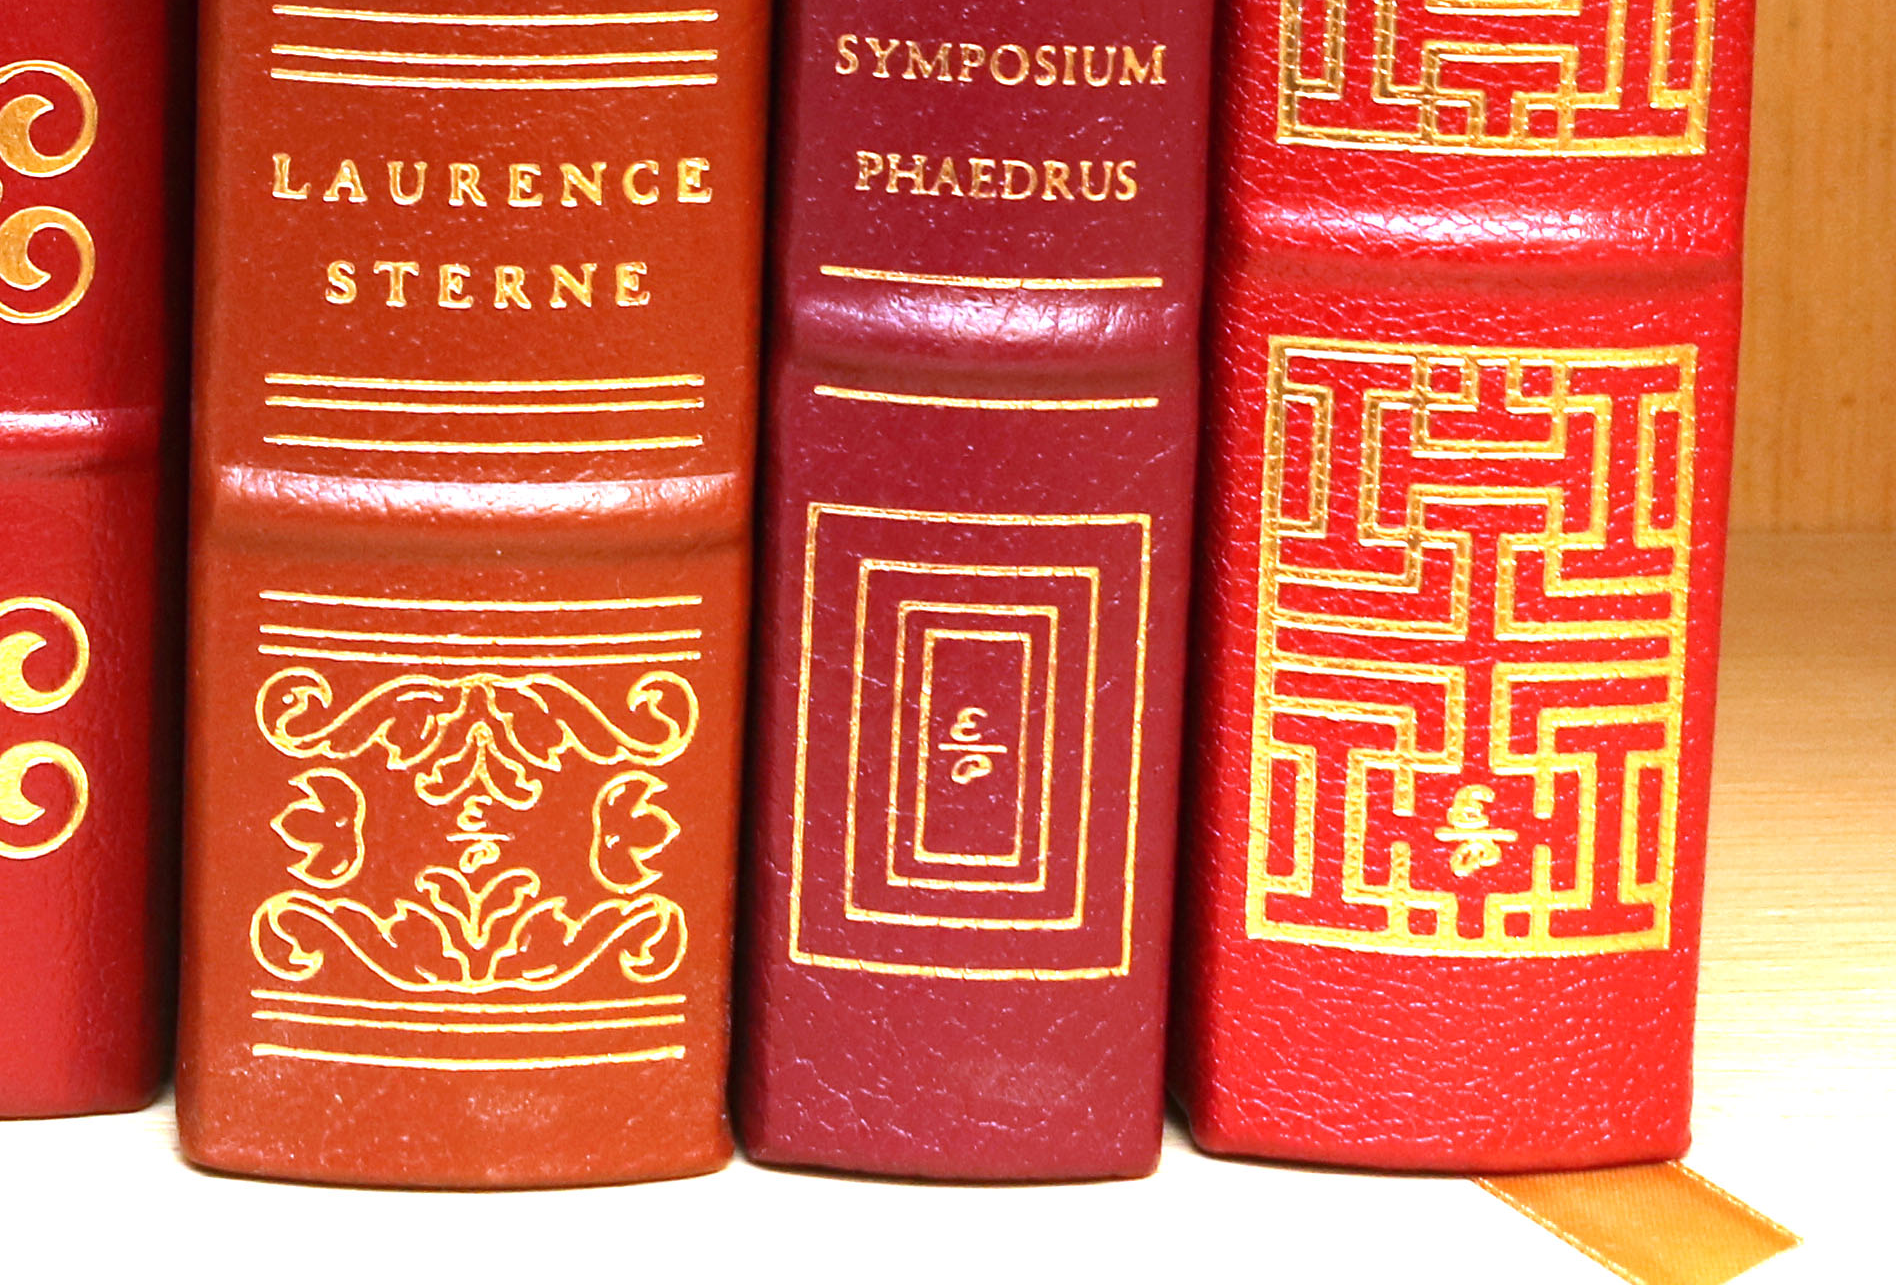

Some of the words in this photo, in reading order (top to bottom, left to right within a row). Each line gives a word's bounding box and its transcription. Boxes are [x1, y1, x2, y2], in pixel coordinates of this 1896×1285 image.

[834, 33, 1168, 87] SYMPOSIUM
[271, 152, 713, 208] LAURENCE
[854, 150, 1138, 202] PHAEDRUS
[324, 260, 651, 310] STERNE
